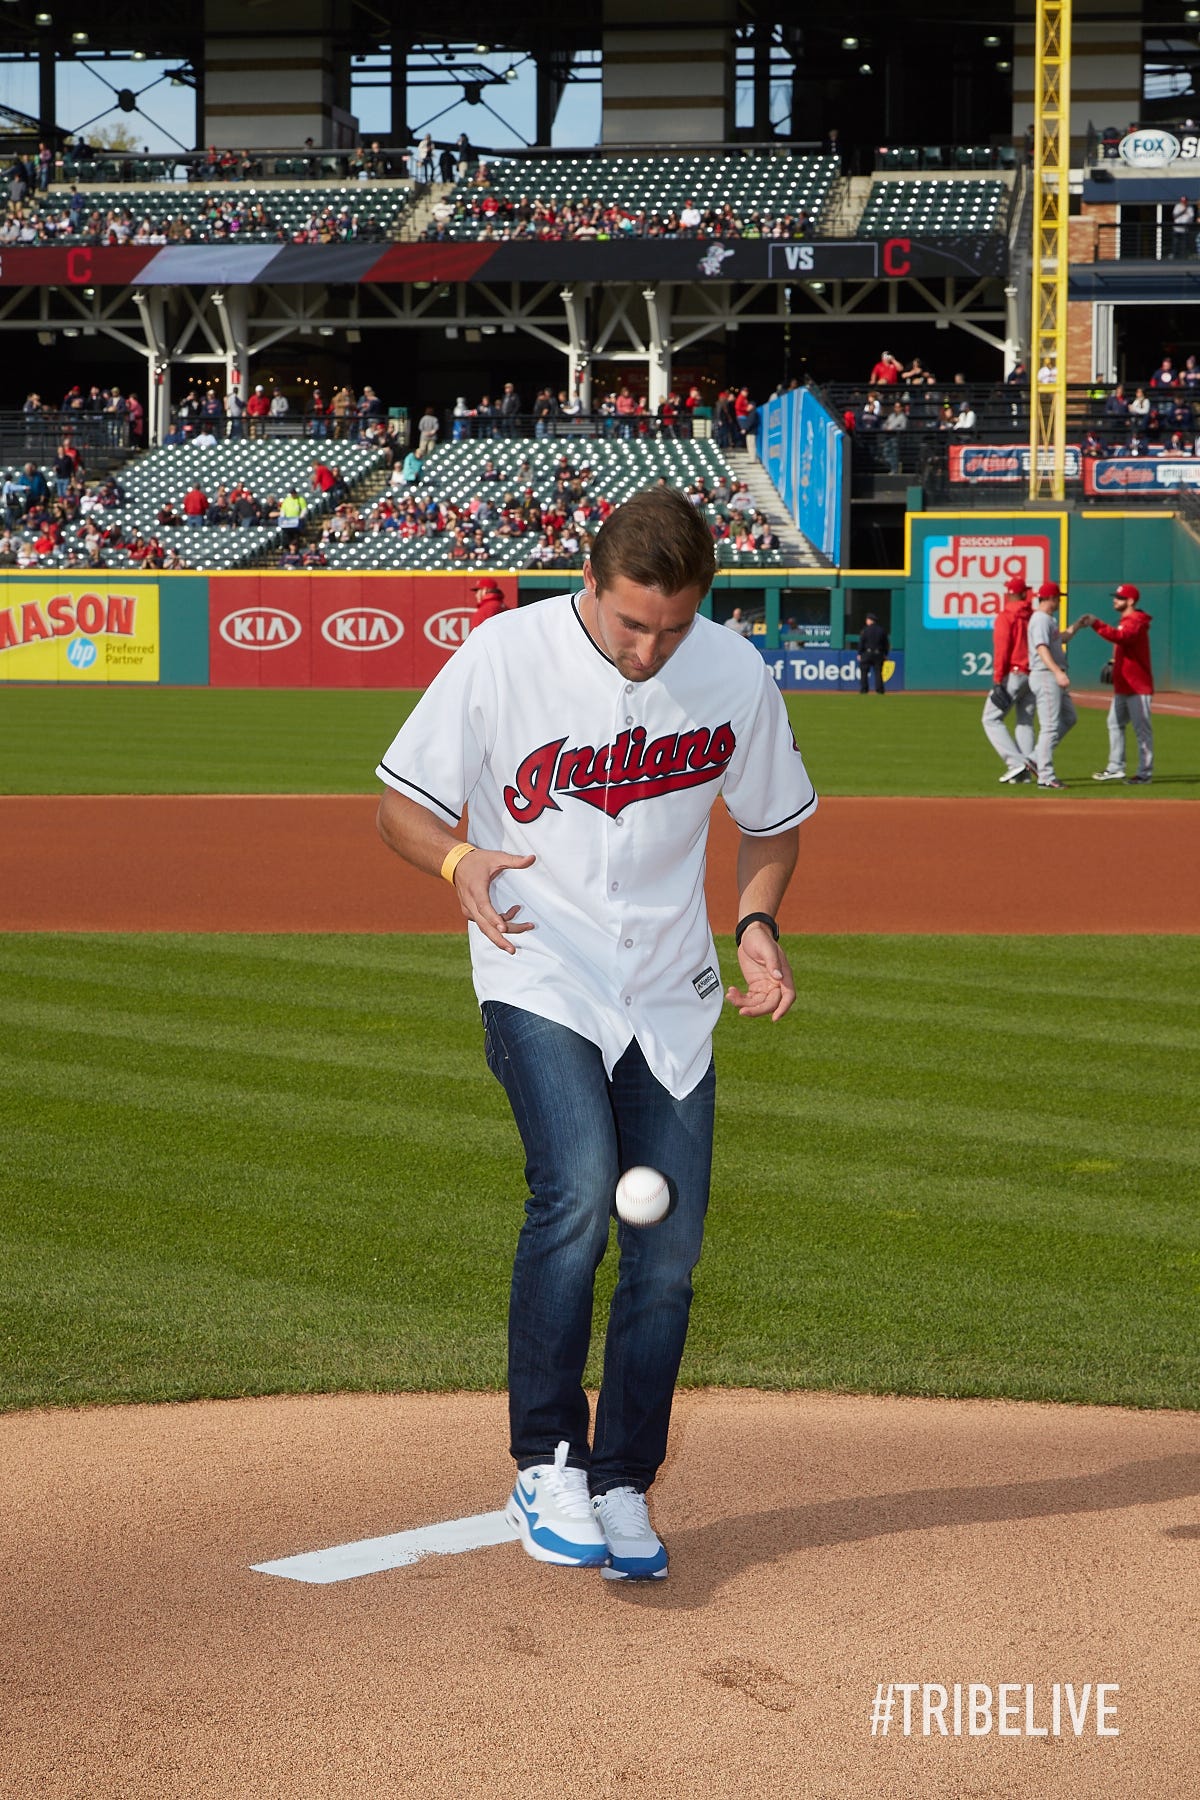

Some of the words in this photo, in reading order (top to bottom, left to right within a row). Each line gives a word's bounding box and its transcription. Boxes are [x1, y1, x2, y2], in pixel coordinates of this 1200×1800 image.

[1133, 138, 1164, 152] FOX
[1180, 136, 1200, 158] S
[67, 247, 92, 284] C
[784, 246, 815, 271] VS
[883, 238, 911, 276] C
[959, 536, 1014, 547] DISCOUNT
[935, 536, 1027, 581] drug
[233, 617, 288, 641] KIA
[336, 617, 391, 641] KIA
[70, 638, 95, 668] hp
[105, 643, 155, 655] Preferred
[105, 655, 144, 665] Partner
[503, 720, 736, 824] Indians
